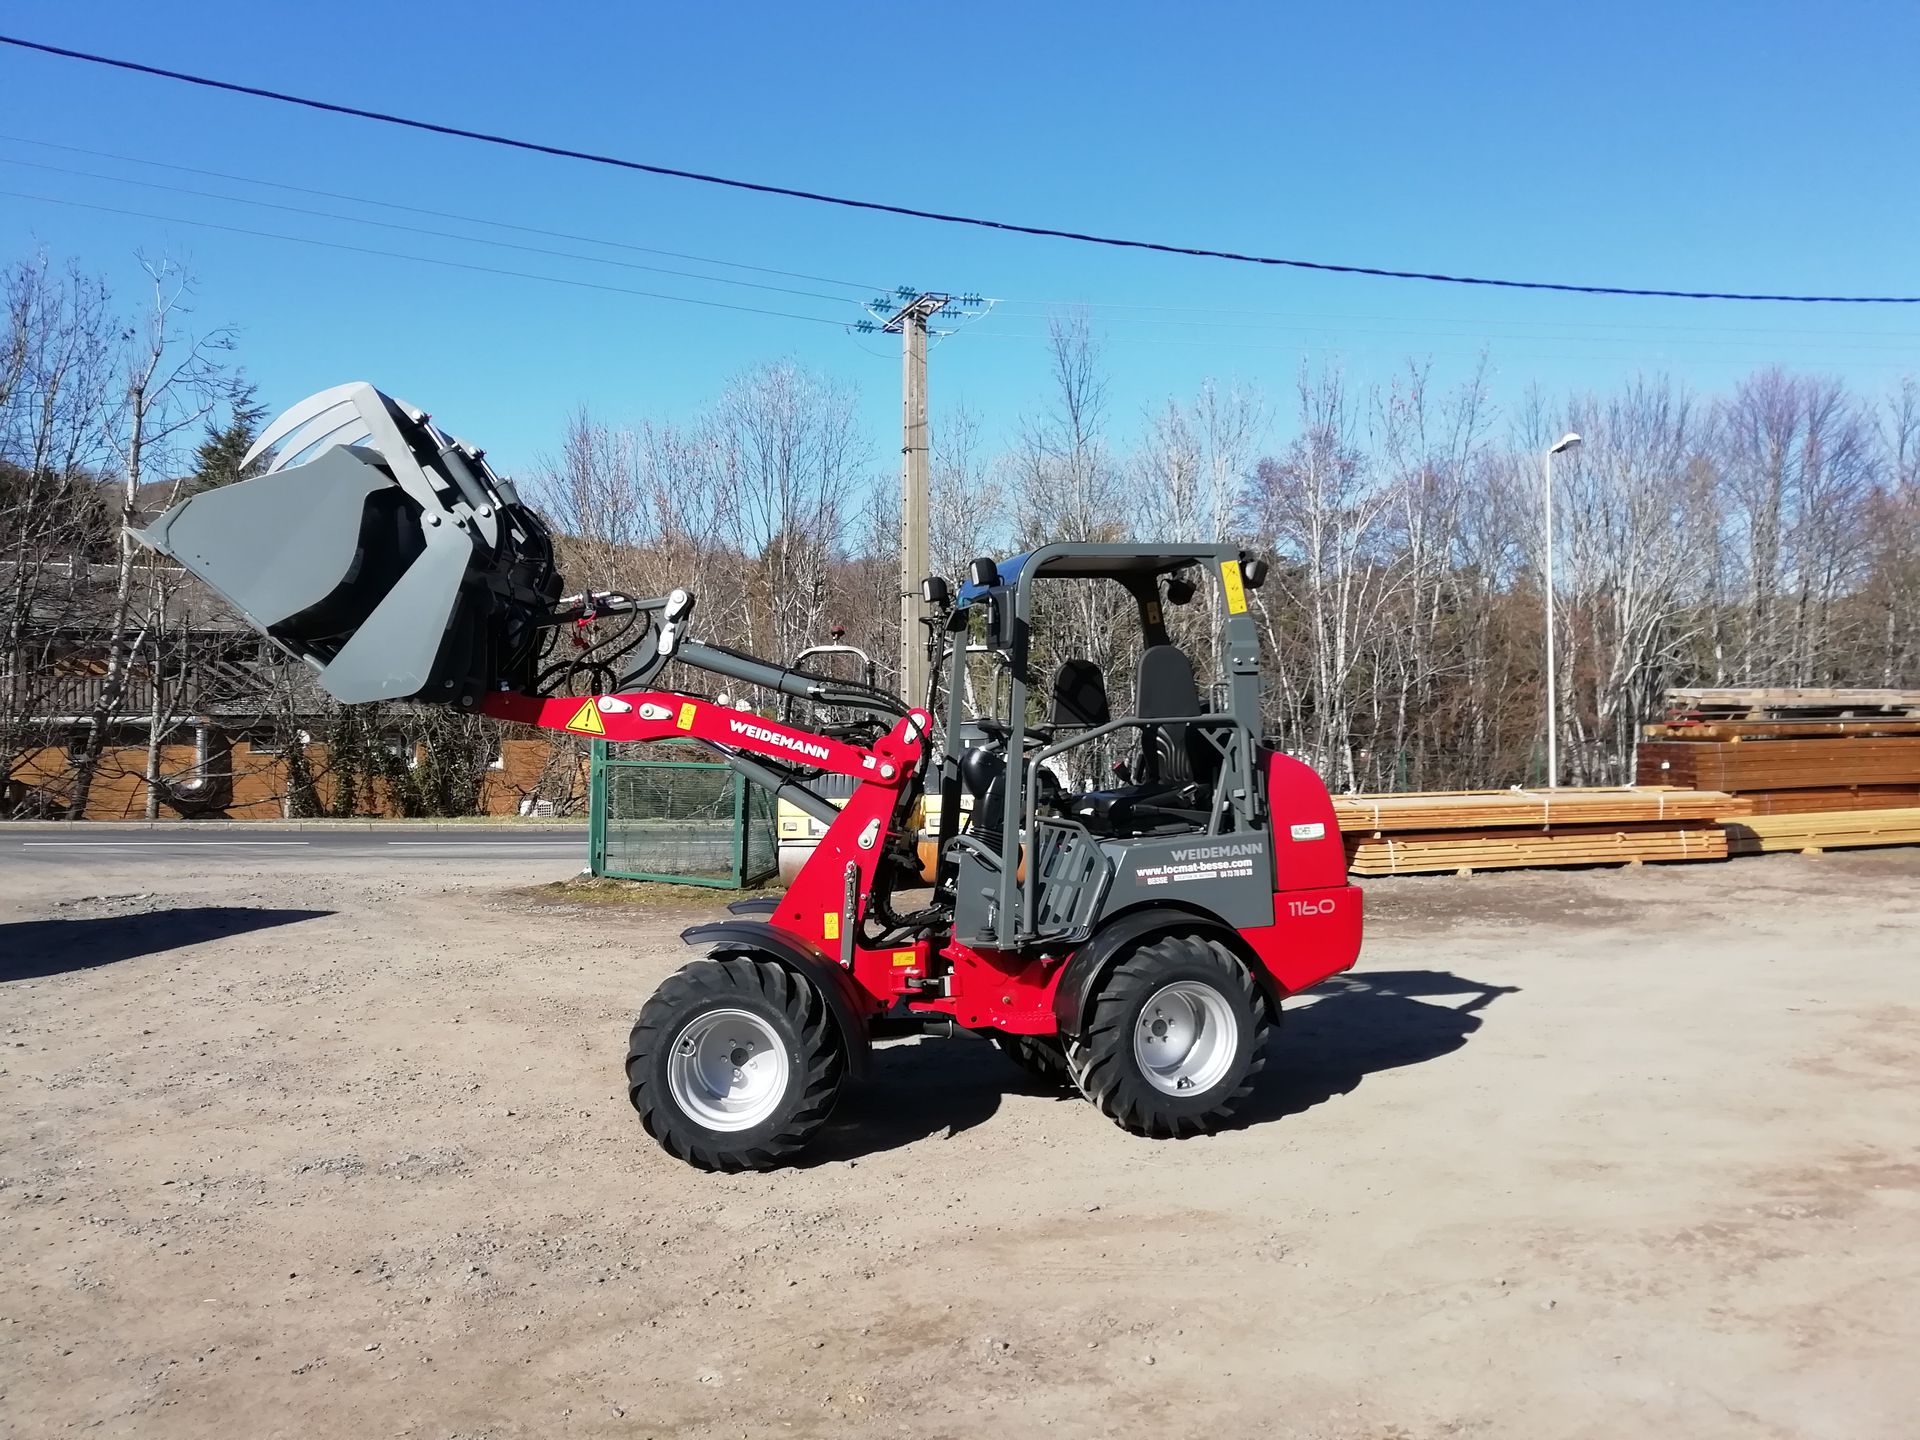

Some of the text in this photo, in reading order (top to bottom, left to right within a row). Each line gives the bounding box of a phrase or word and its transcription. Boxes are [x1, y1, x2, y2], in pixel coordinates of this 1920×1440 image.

[729, 719, 829, 760] WEIDEMANN
[1171, 842, 1263, 861] WEIDEMANN
[1136, 859, 1253, 877] www.locmat-besse.com
[1147, 876, 1168, 885] BESSE
[1288, 898, 1336, 917] 1160
